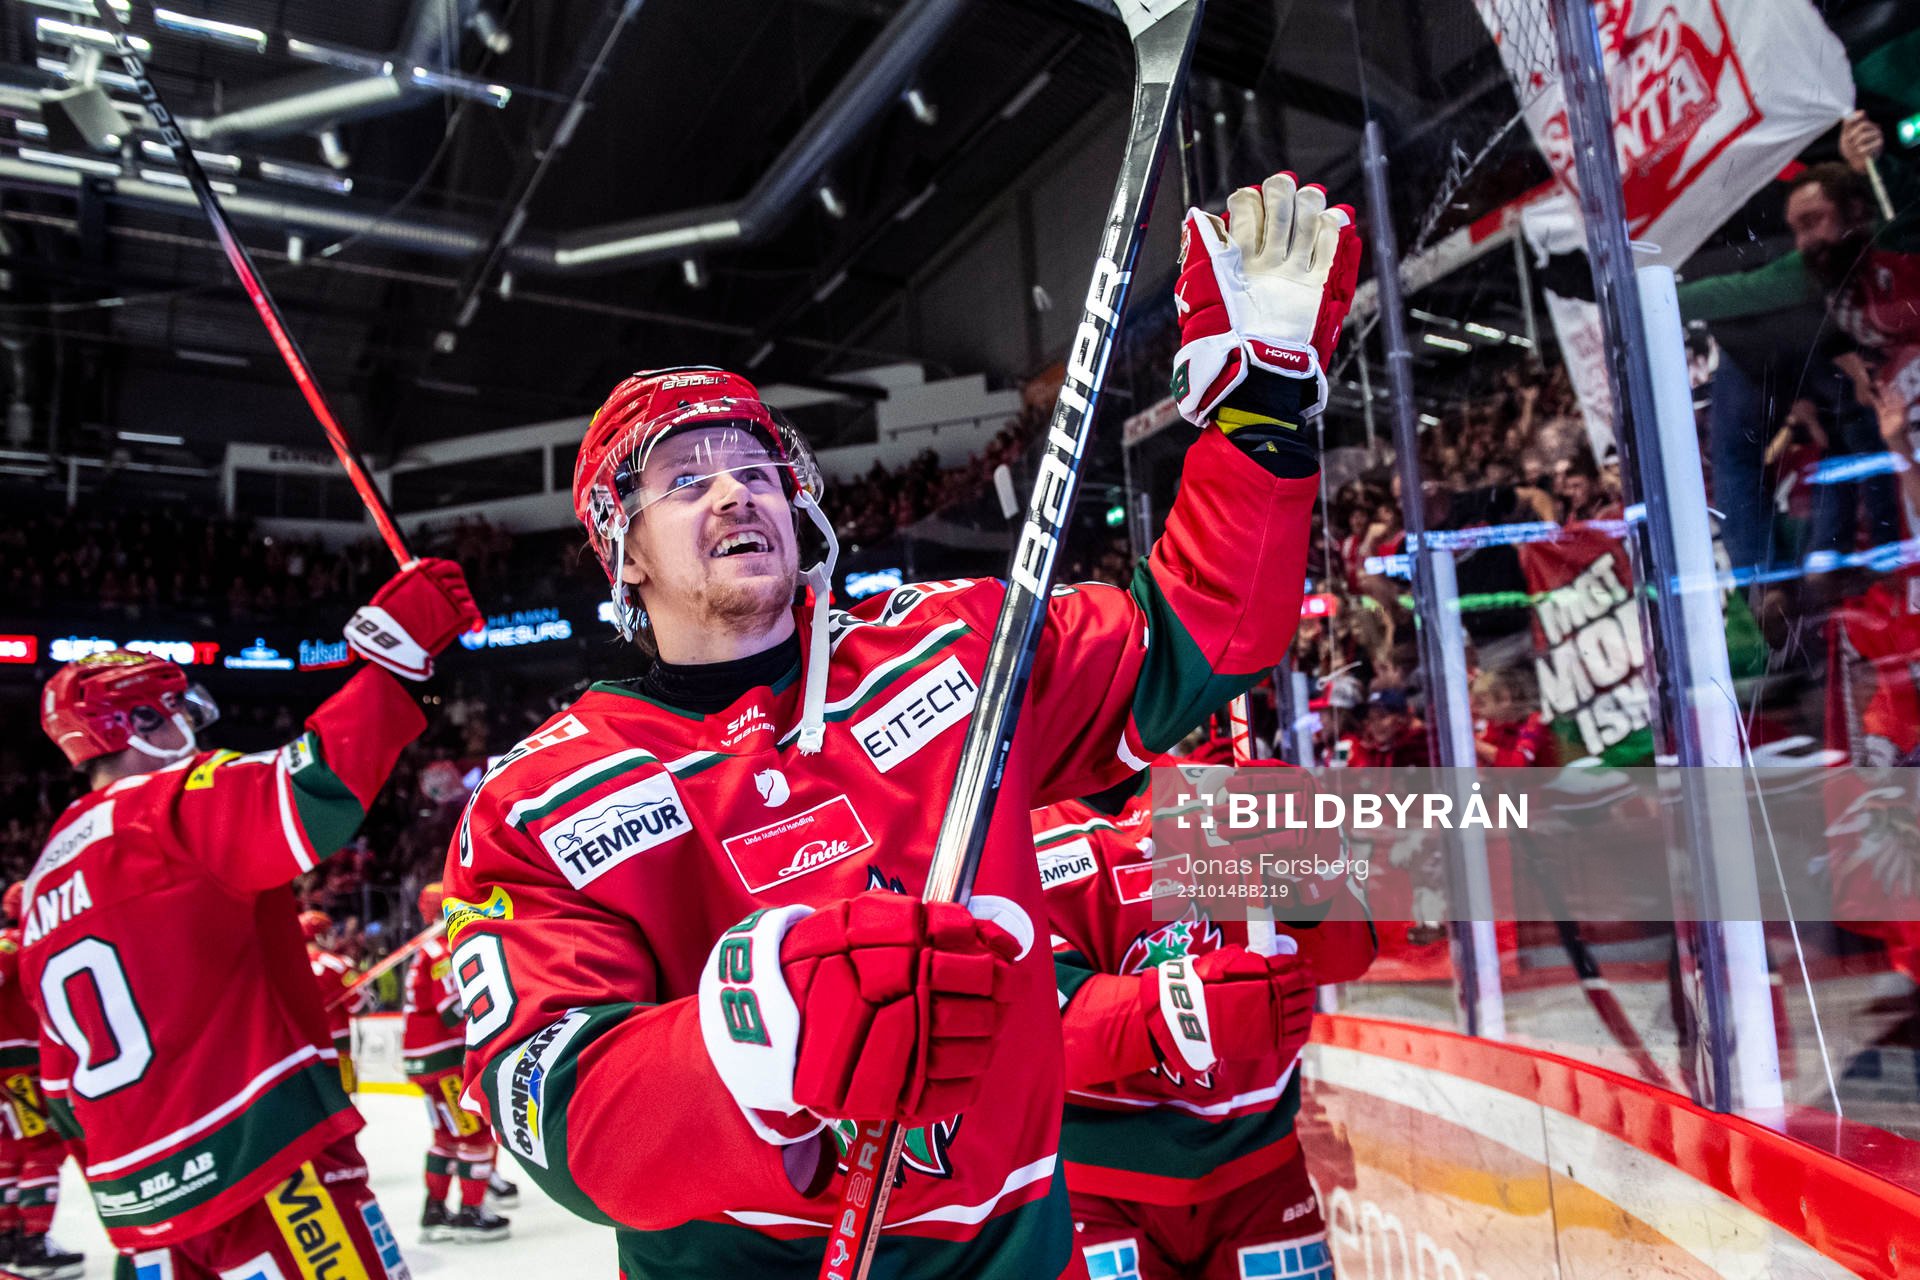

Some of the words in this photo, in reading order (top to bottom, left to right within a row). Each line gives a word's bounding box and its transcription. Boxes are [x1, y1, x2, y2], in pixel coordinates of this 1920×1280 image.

[1265, 347, 1301, 364] MACH
[727, 704, 766, 736] SHL
[564, 804, 684, 875] TEMPUR
[778, 840, 850, 877] Linde
[40, 934, 155, 1101] 0
[182, 1151, 216, 1181] AB
